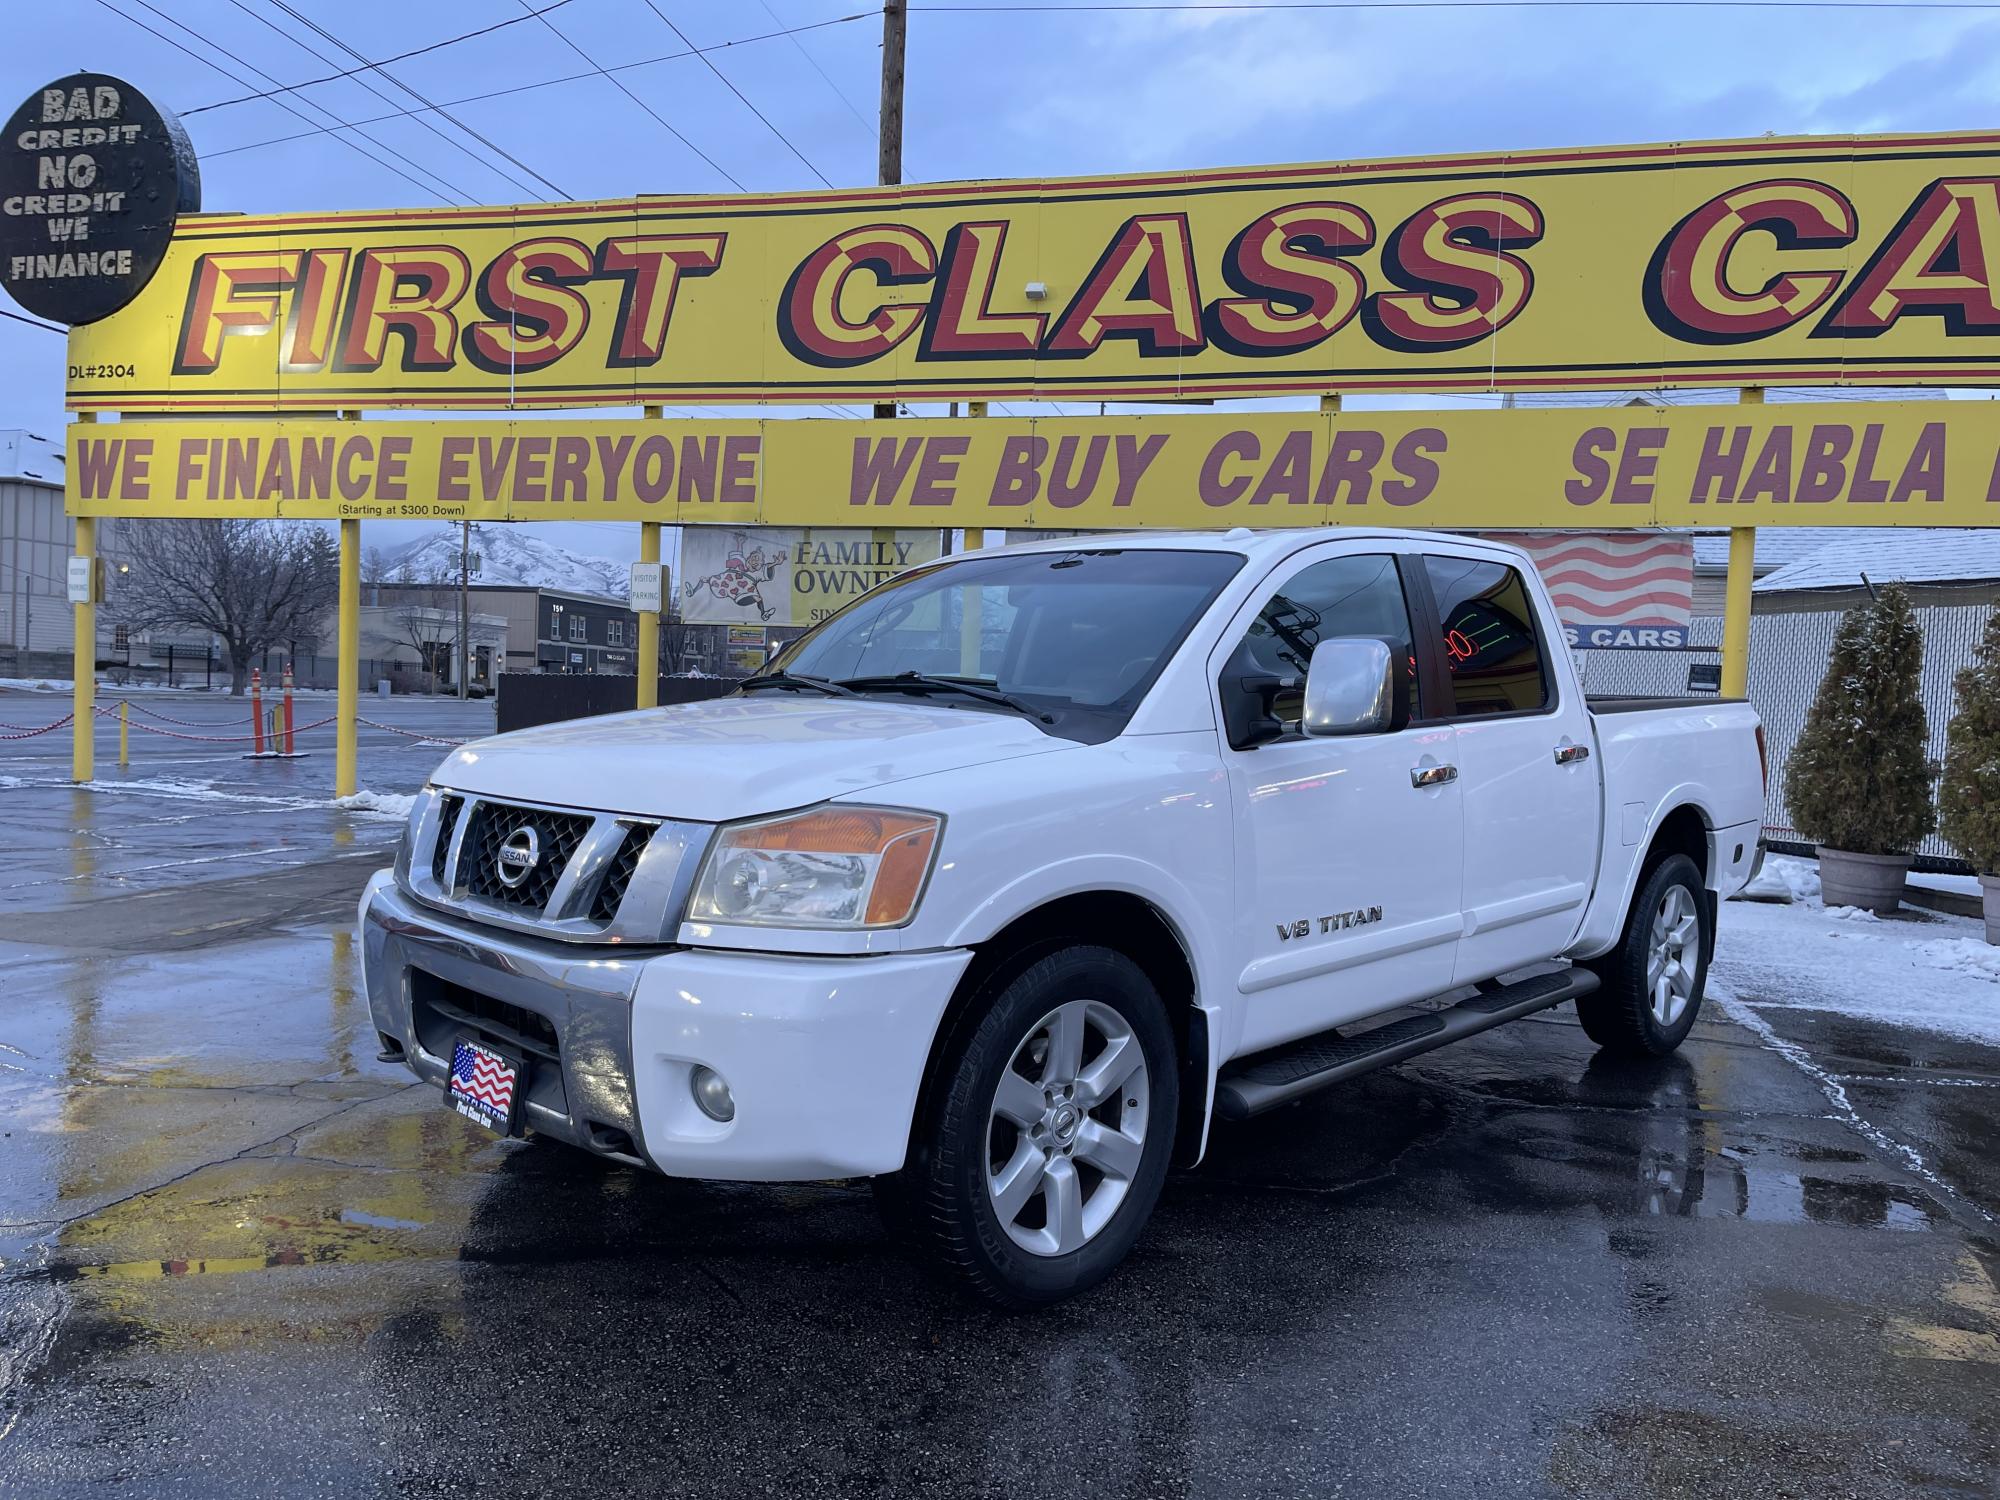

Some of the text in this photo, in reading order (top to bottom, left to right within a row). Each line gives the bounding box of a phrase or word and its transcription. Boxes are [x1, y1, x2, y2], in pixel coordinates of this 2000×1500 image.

[42, 86, 120, 123] BAD
[17, 125, 142, 150] CREDIT
[38, 154, 97, 189] NO
[3, 191, 126, 215] CREDIT
[48, 216, 89, 242] WE
[11, 250, 132, 280] FINANCE
[171, 232, 728, 375] FIRST
[776, 191, 1545, 368] CLASS
[68, 364, 135, 379] DL#2304
[77, 435, 763, 504] WE FINANCE EVERYONE
[849, 428, 1448, 508] WE BUY CARS
[1564, 427, 1670, 506] SE
[1689, 422, 1947, 504] HABLA
[338, 504, 465, 516] (Starting at $300 Down)
[794, 541, 914, 566] FAMILY
[633, 574, 658, 583] VISITOR
[794, 569, 903, 594] OWNE
[632, 591, 659, 601] PARKING
[1590, 629, 1682, 648] CARS
[1276, 905, 1383, 941] V8 TITAN
